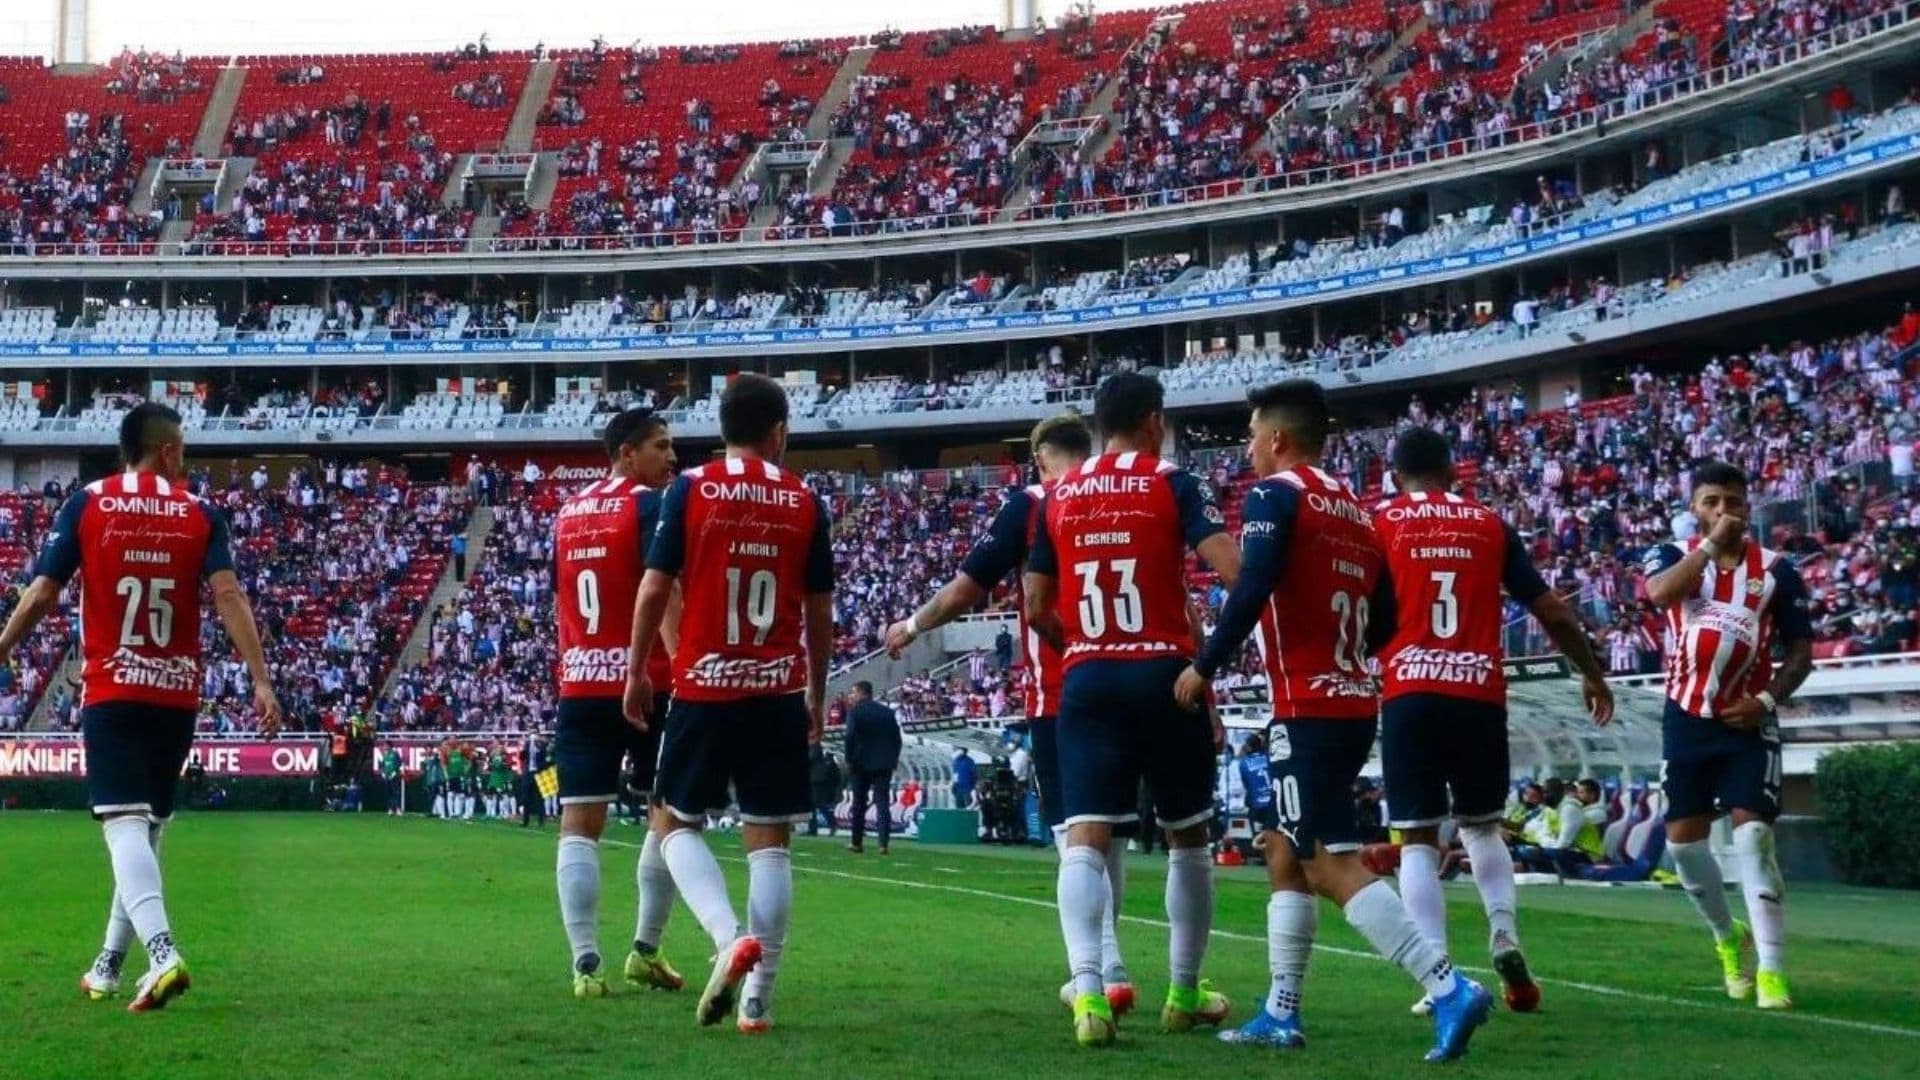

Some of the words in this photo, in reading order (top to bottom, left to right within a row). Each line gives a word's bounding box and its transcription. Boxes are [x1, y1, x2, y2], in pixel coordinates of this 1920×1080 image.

[549, 465, 607, 480] AKRON
[701, 481, 800, 508] OMNILIFE
[1056, 474, 1150, 501] OMNILIFE
[100, 497, 189, 518] OMNILIFE
[1386, 503, 1486, 521] OMNILIFE
[116, 576, 176, 648] 25
[577, 568, 600, 635] 9
[726, 567, 777, 646] 19
[1074, 558, 1144, 640] 33
[1430, 571, 1458, 639] 3
[113, 666, 195, 692] CHIVASTV
[1396, 663, 1490, 687] CHIVASTV
